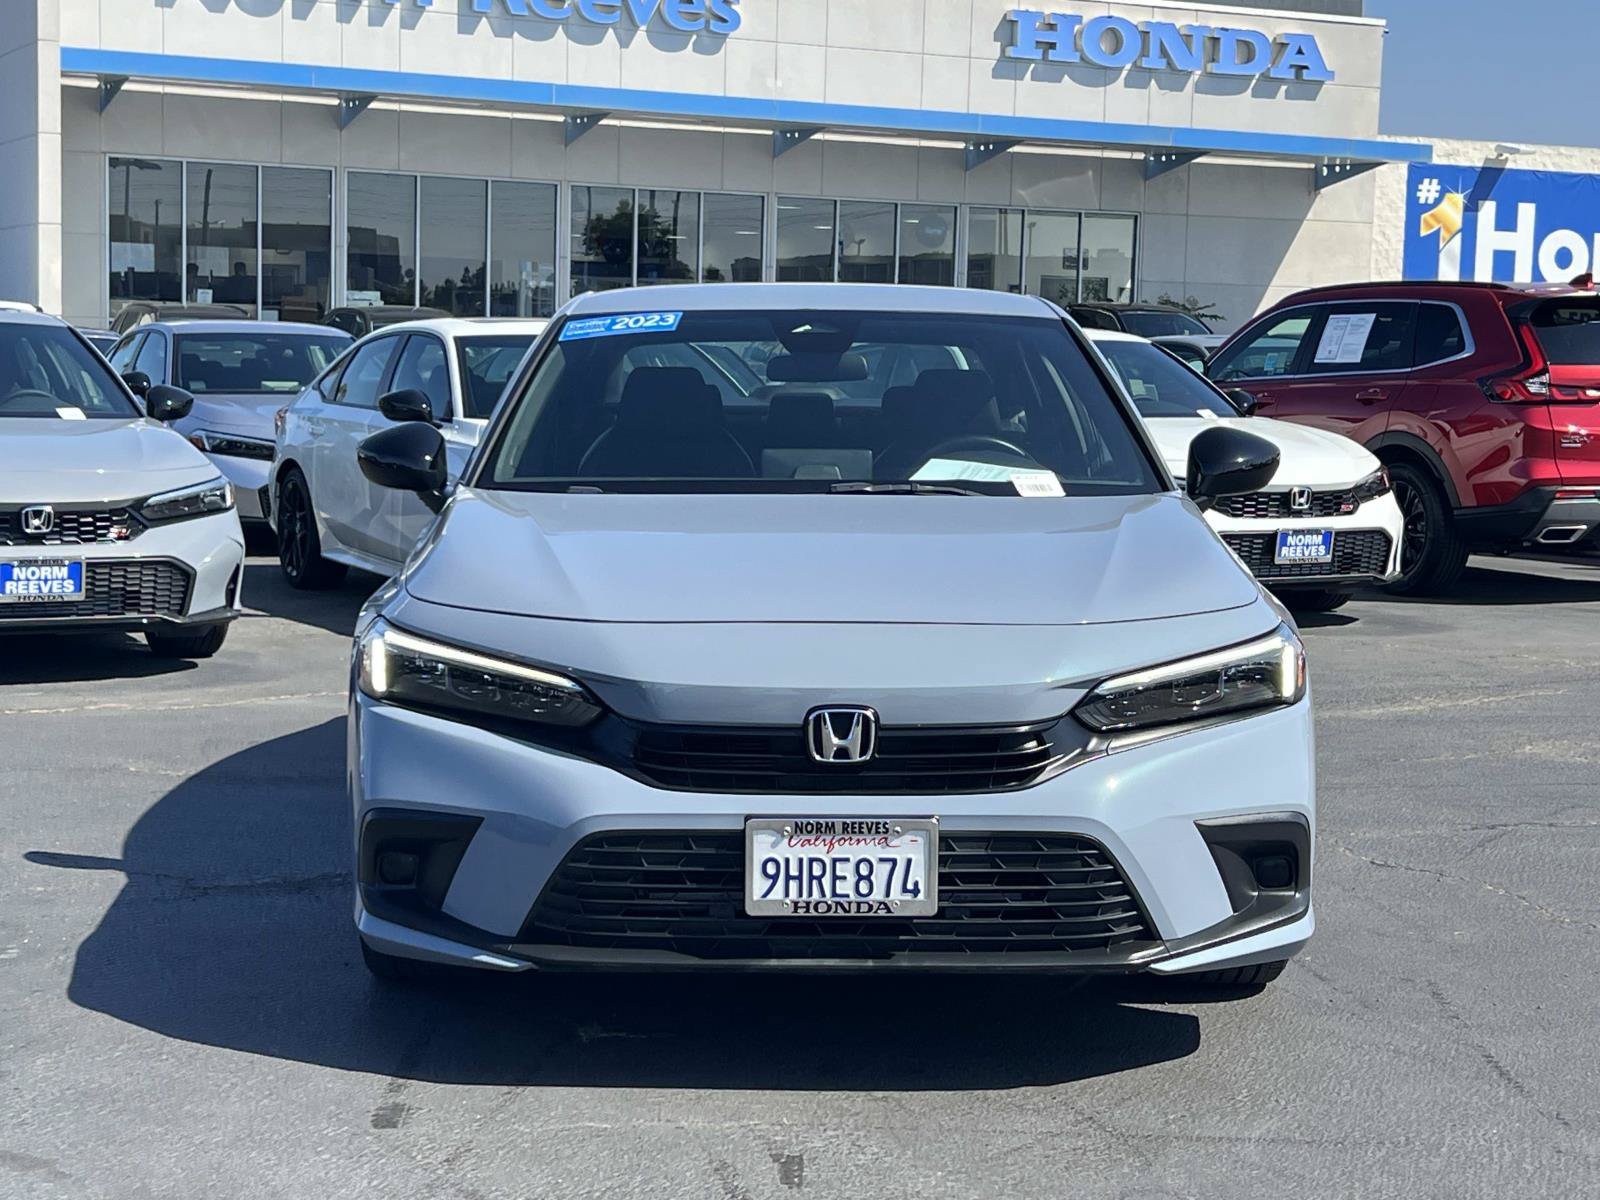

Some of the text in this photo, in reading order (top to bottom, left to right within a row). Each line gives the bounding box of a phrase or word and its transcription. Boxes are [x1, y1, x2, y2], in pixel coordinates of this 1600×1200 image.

[1004, 10, 1335, 82] HONDA
[1473, 200, 1600, 283] Ho
[611, 314, 677, 330] 2023
[1287, 534, 1323, 547] NORM
[1281, 545, 1326, 558] REEVES
[12, 566, 68, 581] NORM
[5, 579, 75, 594] REEVES
[794, 821, 889, 835] NORM REEVES
[787, 835, 901, 854] California
[760, 856, 921, 899] 9HRE874
[790, 900, 895, 914] HONDA
